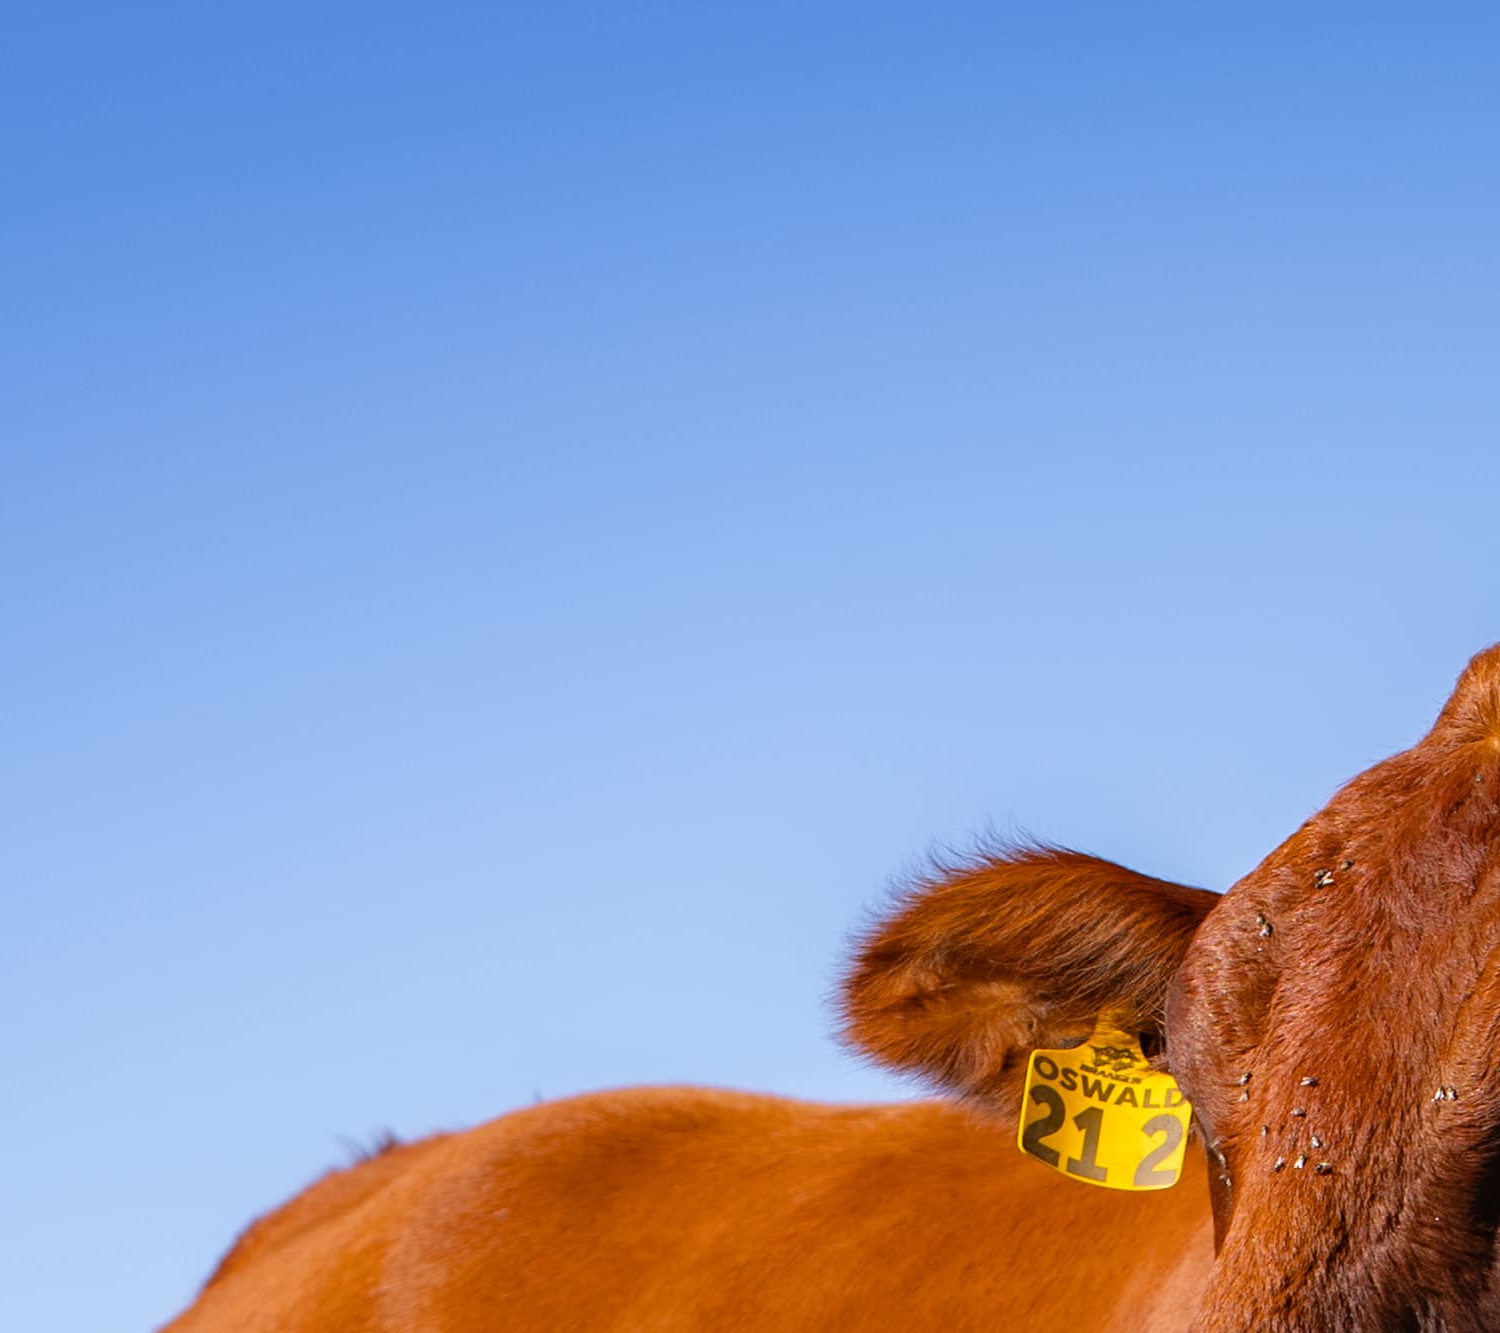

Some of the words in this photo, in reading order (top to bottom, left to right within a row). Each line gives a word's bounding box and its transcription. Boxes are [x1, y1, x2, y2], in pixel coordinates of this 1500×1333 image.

[1033, 1055, 1186, 1108] OSWALD
[1022, 1084, 1108, 1182] 21
[1133, 1113, 1183, 1186] 2
